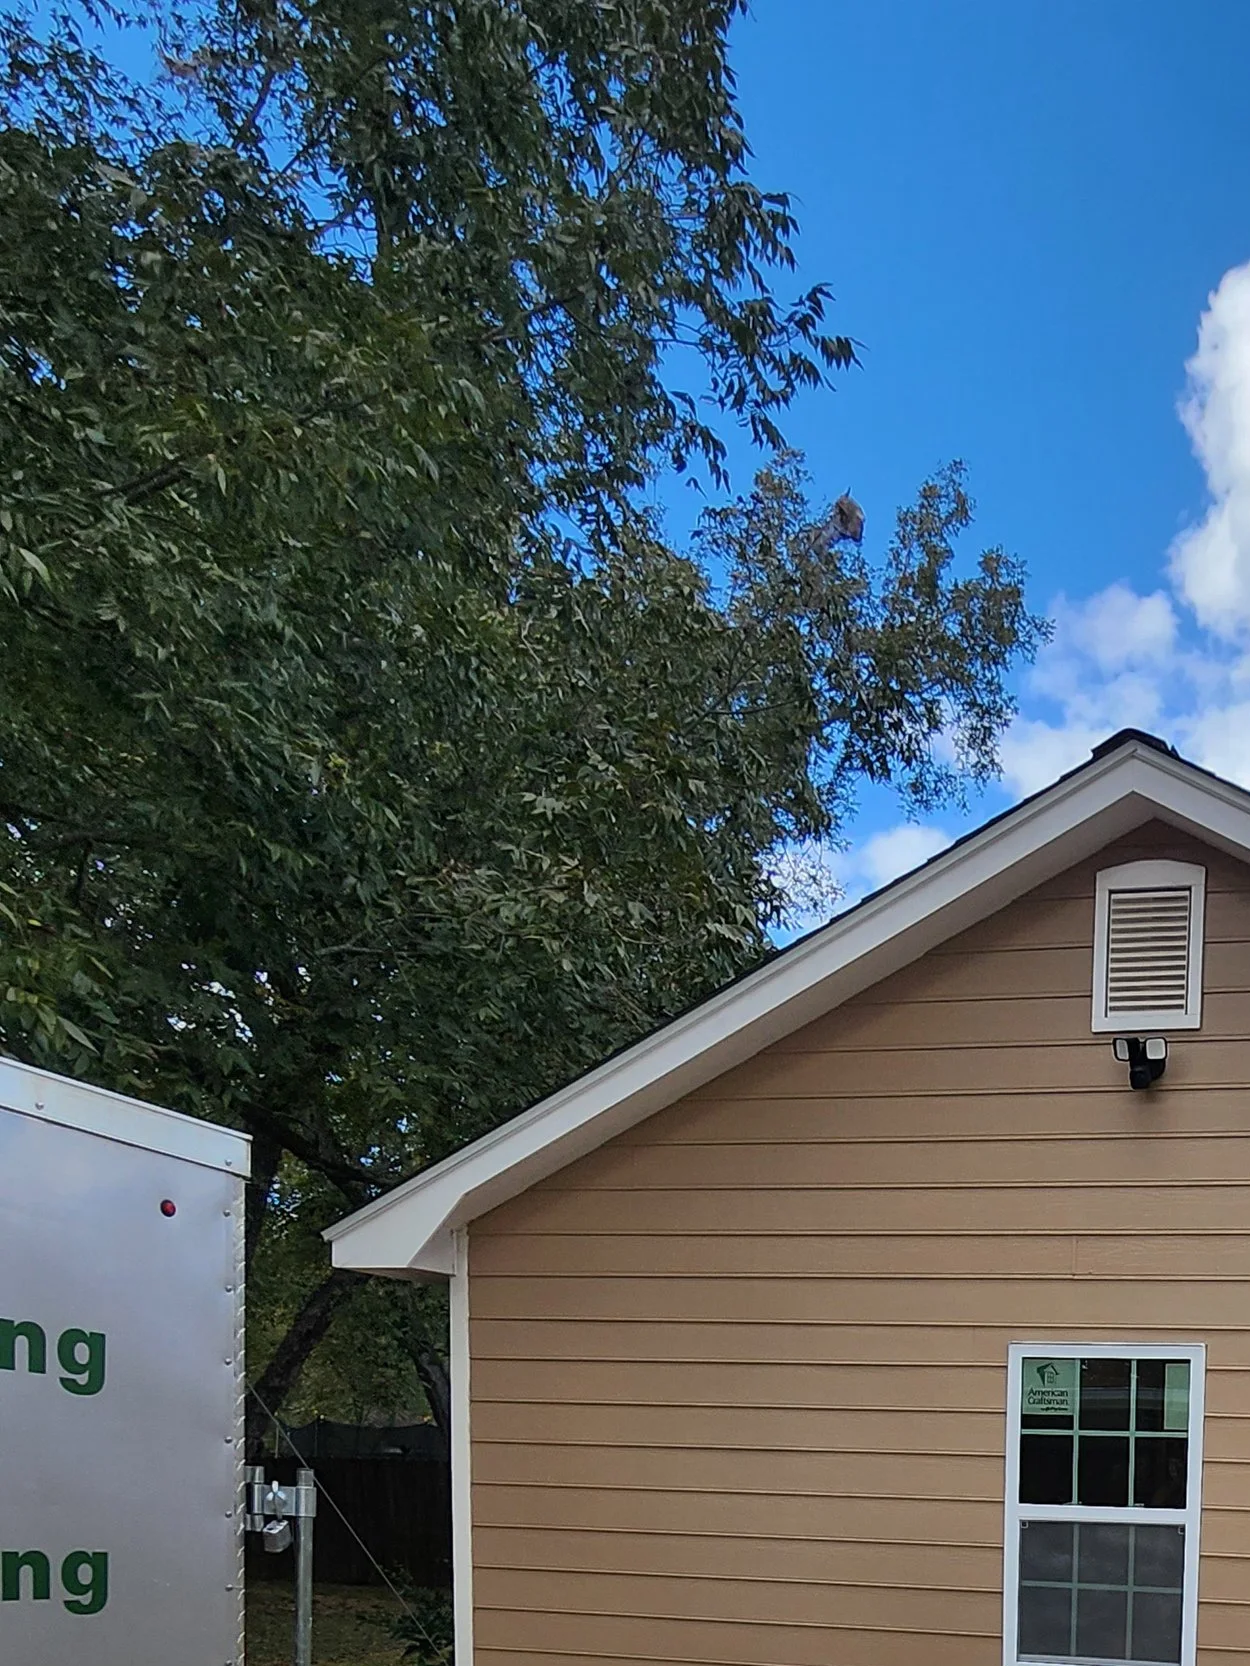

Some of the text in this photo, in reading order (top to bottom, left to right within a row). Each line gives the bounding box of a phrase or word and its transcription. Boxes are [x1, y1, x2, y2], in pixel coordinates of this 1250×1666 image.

[0, 1317, 106, 1396] ng
[1027, 1397, 1069, 1405] Craftsman
[1028, 1388, 1068, 1397] American
[1, 1550, 109, 1615] ng
